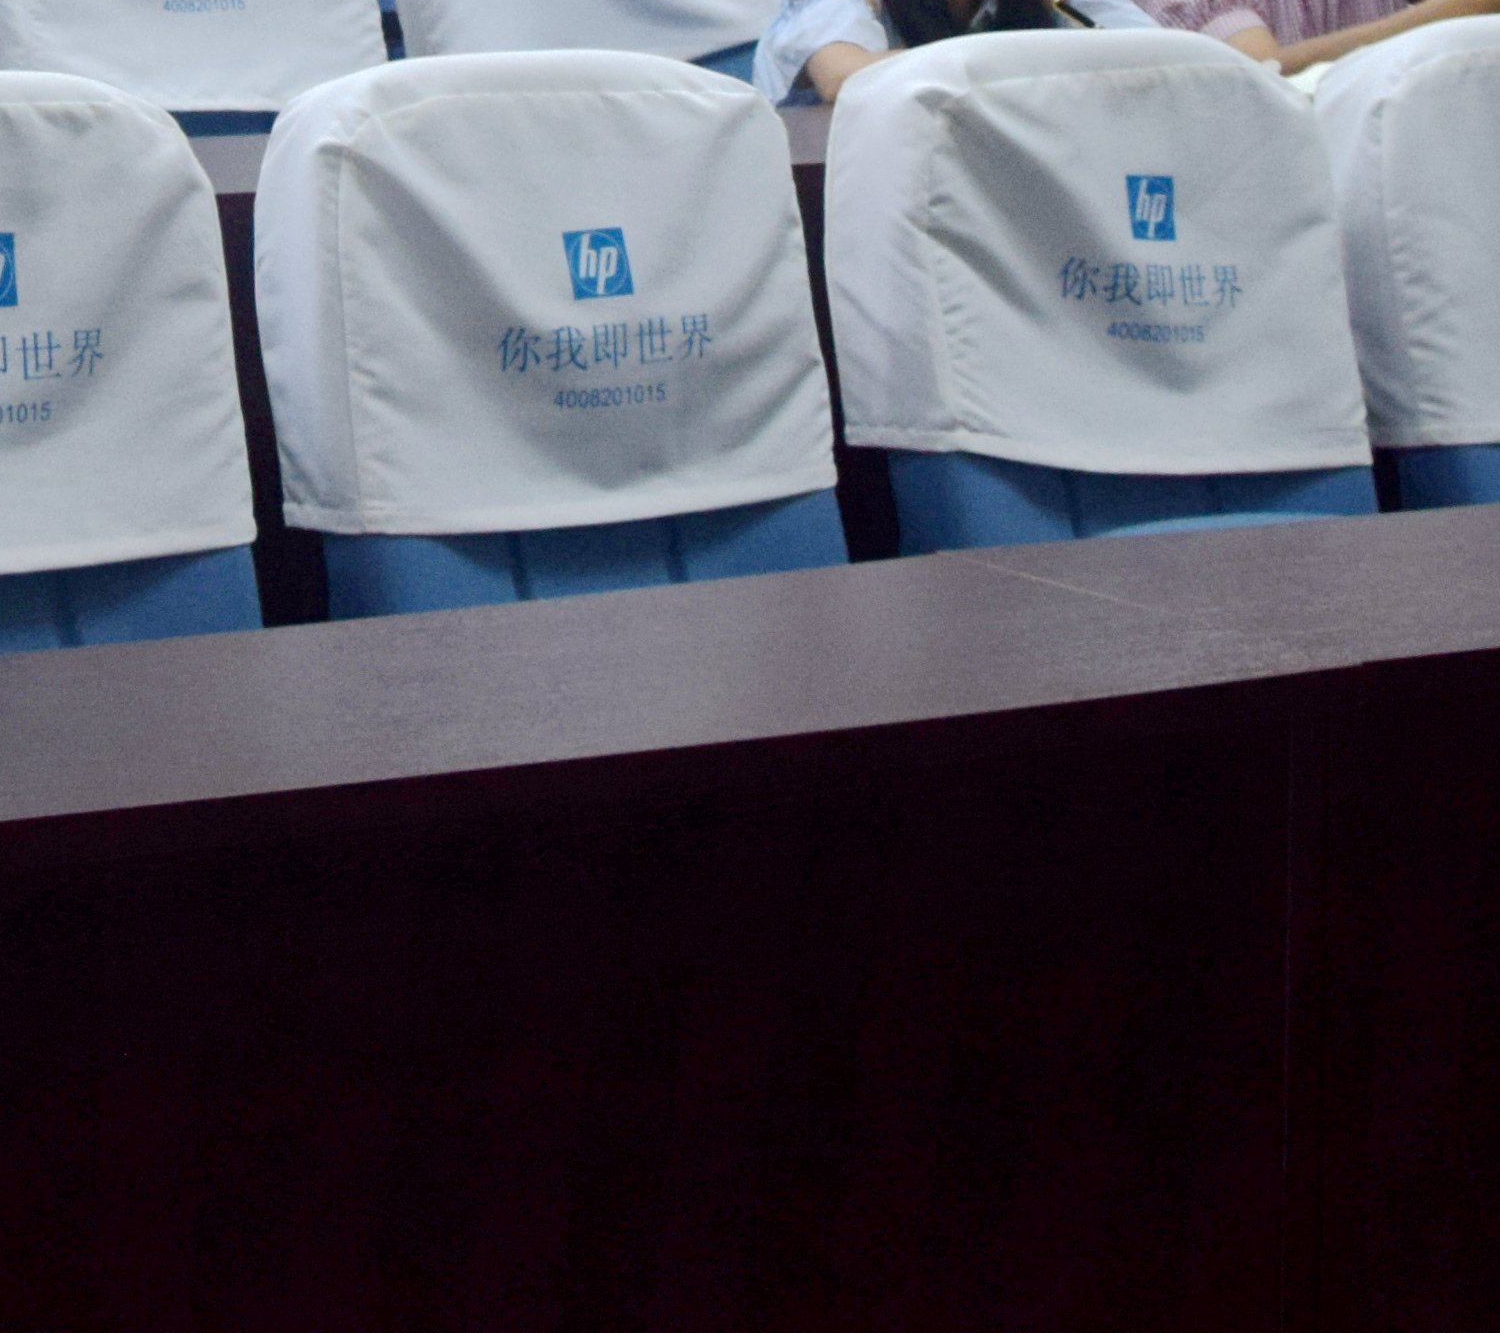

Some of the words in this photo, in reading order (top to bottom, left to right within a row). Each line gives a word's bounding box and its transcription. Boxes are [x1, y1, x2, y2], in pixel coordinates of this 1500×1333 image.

[1132, 177, 1170, 240] hp
[572, 230, 626, 299] hp
[1060, 256, 1245, 309] 你我即世界
[500, 314, 714, 374] 你我即世界
[554, 383, 667, 410] 4008201015
